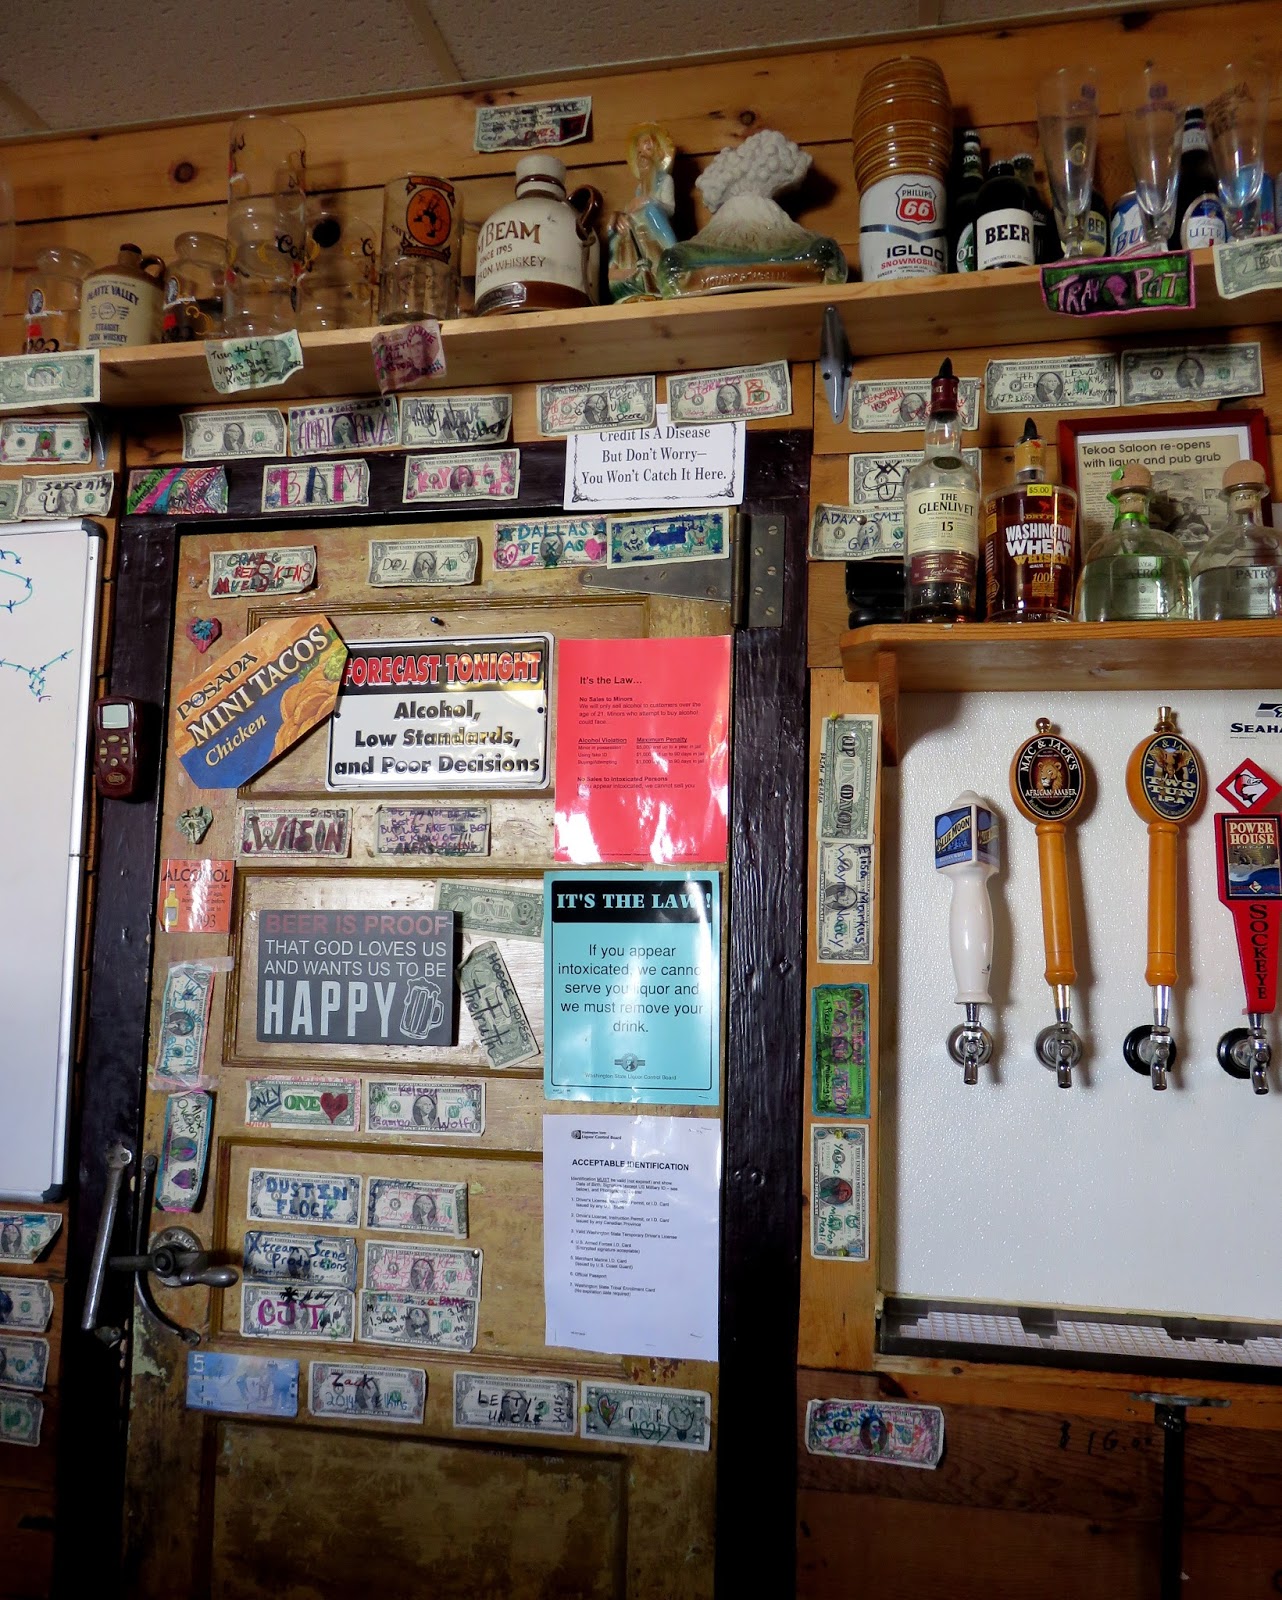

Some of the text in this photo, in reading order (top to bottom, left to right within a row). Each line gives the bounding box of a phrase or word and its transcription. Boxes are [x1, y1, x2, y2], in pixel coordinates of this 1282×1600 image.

[902, 189, 933, 199] PHILLIPS
[904, 201, 931, 217] 66
[486, 220, 541, 247] BEAM
[985, 224, 1030, 245] BEER
[887, 245, 944, 262] IGLOO
[495, 255, 546, 272] WHISKEY
[111, 285, 139, 306] VALLEY
[600, 425, 711, 442] Credit Is A Disease
[602, 449, 623, 463] But
[626, 447, 658, 461] Don't
[1082, 440, 1211, 456] Tekoa Saloon re-opens
[1083, 458, 1106, 468] with
[1143, 455, 1166, 465] and
[1169, 454, 1191, 465] pub
[1195, 453, 1221, 464] grub
[581, 465, 727, 485] You Won't Catch It Here.
[940, 493, 958, 501] THE
[918, 501, 974, 517] GLENLIVET
[517, 521, 589, 541] DALLAS
[941, 522, 954, 532] 15
[1005, 523, 1072, 542] WASHINGTON
[518, 540, 586, 557] TEXAS
[848, 536, 880, 550] GAY
[1006, 539, 1071, 557] WHEAT
[344, 651, 541, 685] FORECAST TONIGHT
[176, 651, 259, 721] POSADA
[187, 625, 330, 748] MINI TACOS
[393, 700, 481, 721] Alcohol,
[205, 714, 268, 767] Chicken
[355, 726, 520, 747] Low Standards,
[335, 754, 540, 775] and Poor Decisions
[1020, 739, 1079, 773] MAC & JACK'S
[1145, 776, 1197, 790] TWO
[1147, 785, 1196, 798] TUN
[1025, 788, 1078, 797] AFRICAN AMBER
[951, 817, 971, 837] MOON
[1229, 822, 1274, 834] POWER
[1230, 834, 1275, 845] HOUSE
[556, 893, 595, 909] IT'S
[602, 893, 645, 909] THE
[265, 914, 449, 936] BEER IS PROOF
[829, 905, 850, 949] Nancy
[265, 940, 447, 957] THAT GOD LOVES US
[589, 944, 677, 959] If you appear
[1249, 904, 1269, 1000] SOCKEYE
[264, 960, 447, 977] AND WANTS US TO BE
[638, 966, 657, 976] we
[564, 984, 601, 995] serve
[605, 984, 629, 997] you
[674, 983, 700, 995] and
[263, 979, 397, 1038] HAPPY
[560, 1002, 704, 1017] we must remove your
[612, 1020, 649, 1033] drink.
[284, 1094, 320, 1112] ONE
[438, 1116, 473, 1130] Wolf
[572, 1159, 689, 1171] ACCEPTABLE IDENTIFICATION
[266, 1177, 347, 1201] DUSTIN
[276, 1199, 334, 1219] FLOCK
[309, 1240, 347, 1261] Scene
[193, 1354, 204, 1373] 5
